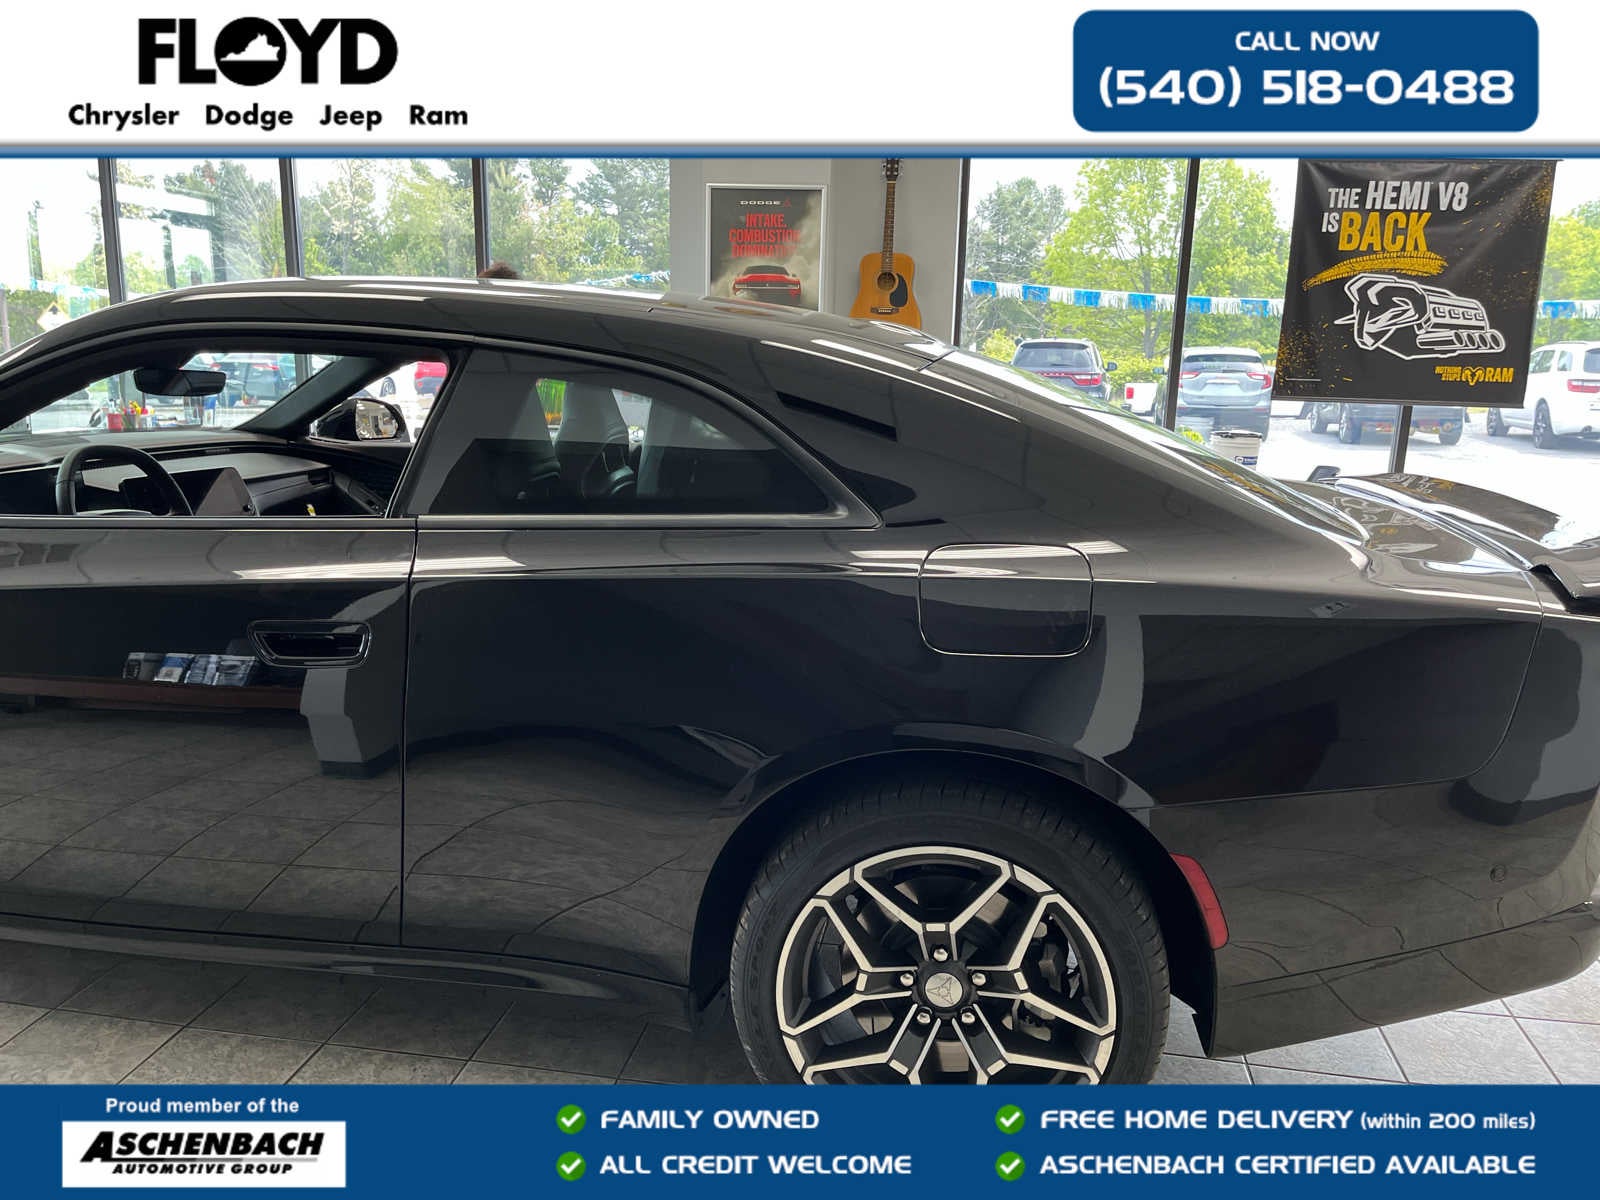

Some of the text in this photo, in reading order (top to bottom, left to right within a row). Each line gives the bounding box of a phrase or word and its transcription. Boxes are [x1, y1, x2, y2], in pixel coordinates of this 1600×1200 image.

[1327, 180, 1469, 212] THE HEMI V8
[1321, 211, 1432, 252] IS BACK
[1485, 367, 1515, 383] RAM
